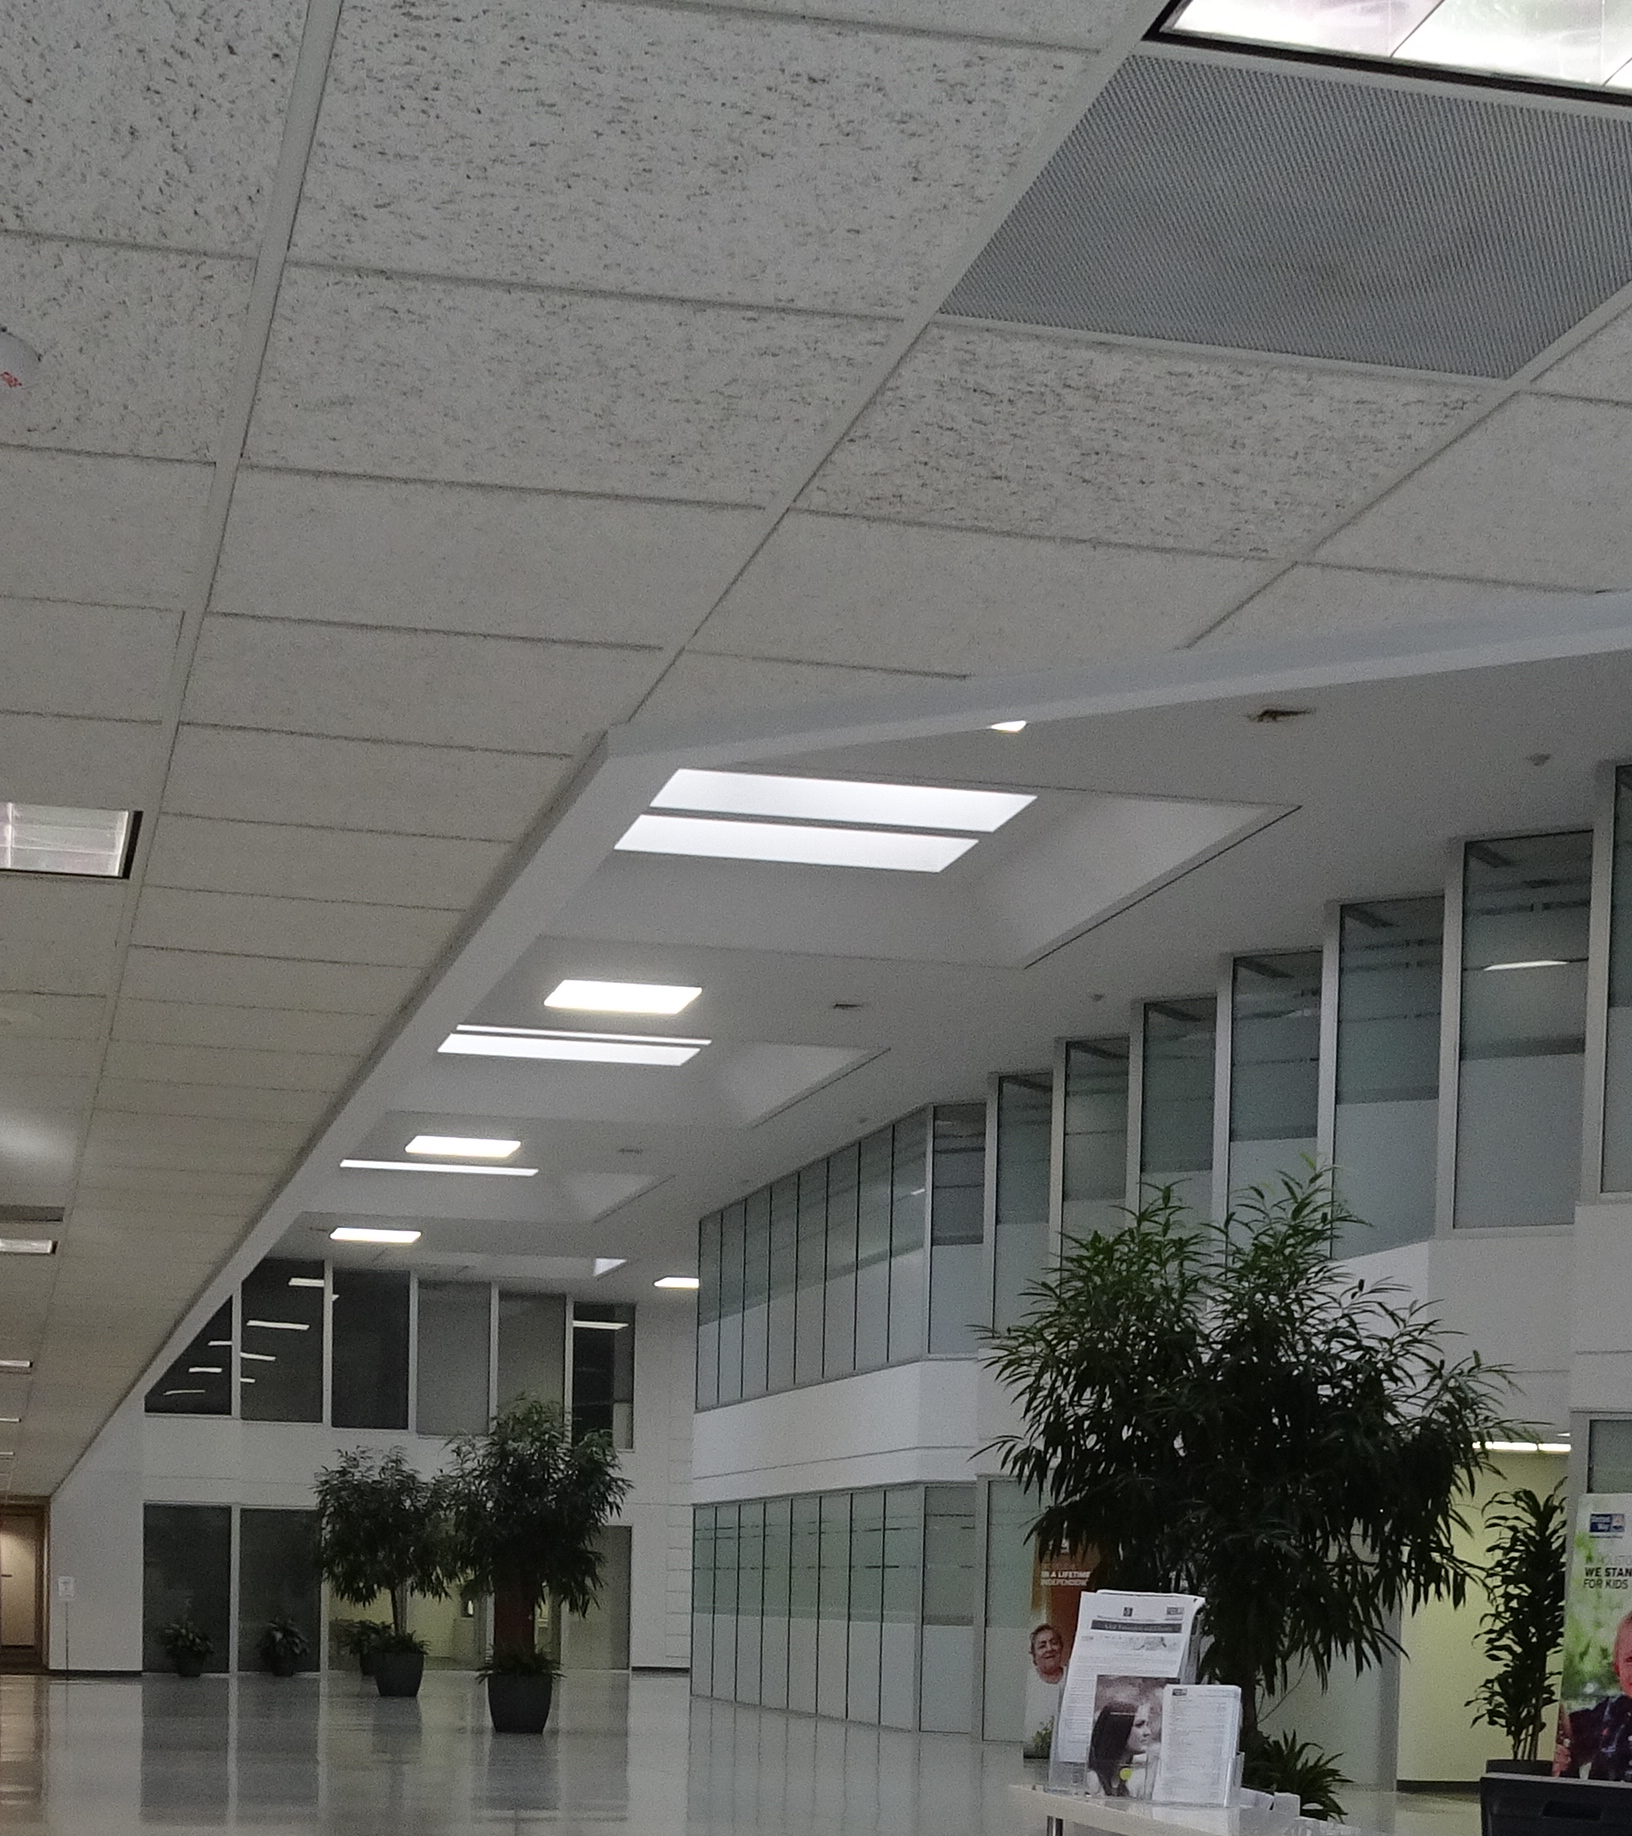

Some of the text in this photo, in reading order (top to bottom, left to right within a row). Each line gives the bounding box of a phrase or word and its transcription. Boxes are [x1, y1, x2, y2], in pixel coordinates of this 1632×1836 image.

[1585, 1567, 1602, 1577] WE
[1583, 1579, 1629, 1589] FOR KIDS
